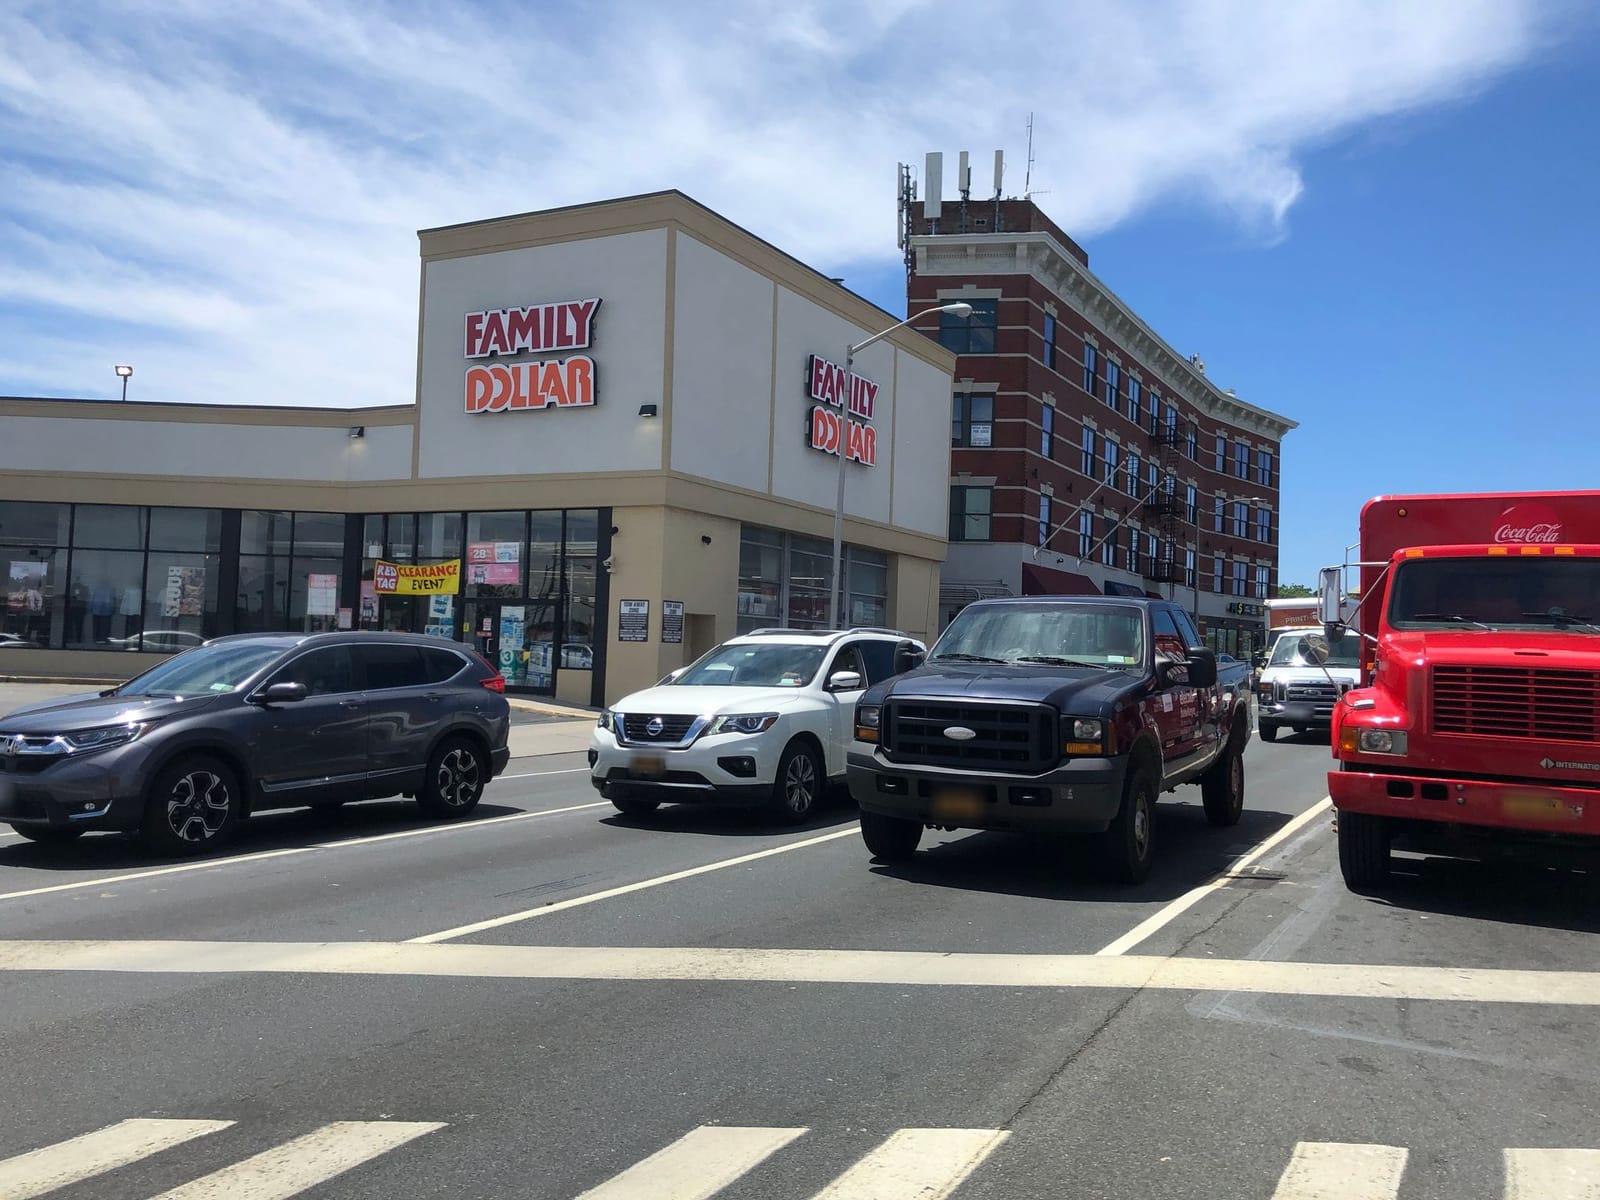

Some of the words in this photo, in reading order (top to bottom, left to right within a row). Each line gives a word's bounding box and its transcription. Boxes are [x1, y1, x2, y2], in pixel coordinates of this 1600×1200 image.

[466, 301, 595, 356] FAMILY
[466, 358, 593, 411] DOLLAR
[1494, 524, 1562, 543] Coca-Cola
[377, 565, 397, 576] RED
[398, 565, 456, 577] CLEARANCE
[377, 578, 396, 589] TAG
[412, 579, 445, 590] EVENT
